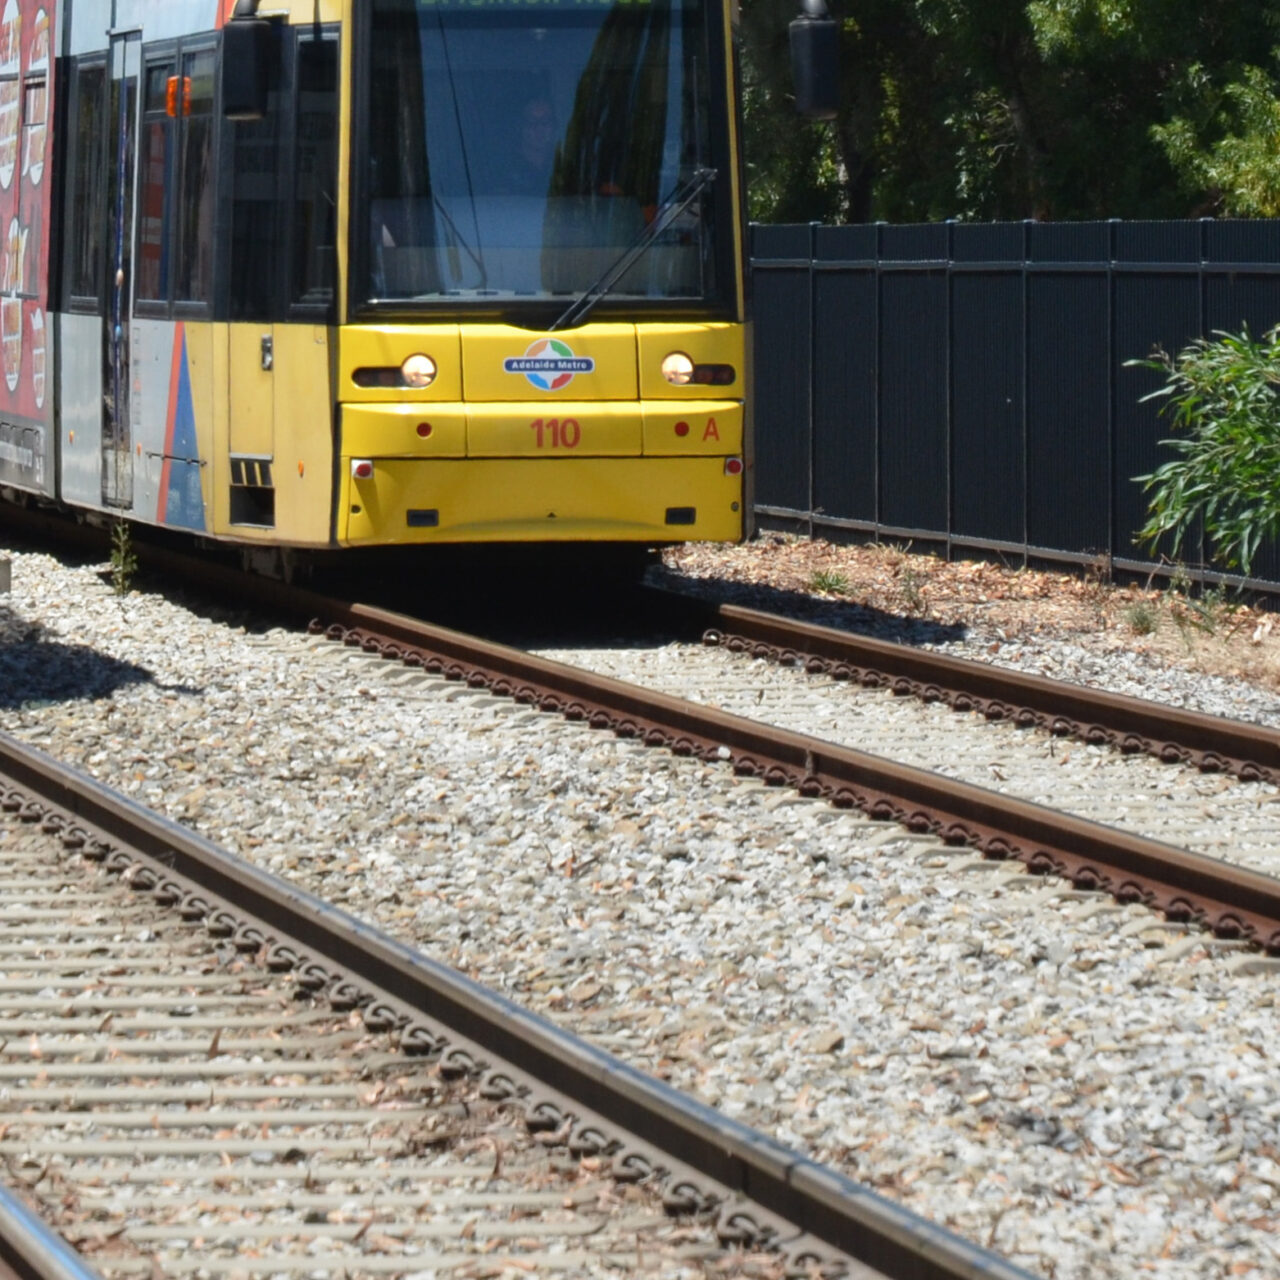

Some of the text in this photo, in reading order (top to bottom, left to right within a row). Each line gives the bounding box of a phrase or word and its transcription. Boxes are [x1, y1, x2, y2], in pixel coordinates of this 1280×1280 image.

[511, 360, 588, 370] Adelaide Metro
[529, 418, 581, 449] 110
[702, 417, 720, 442] A
